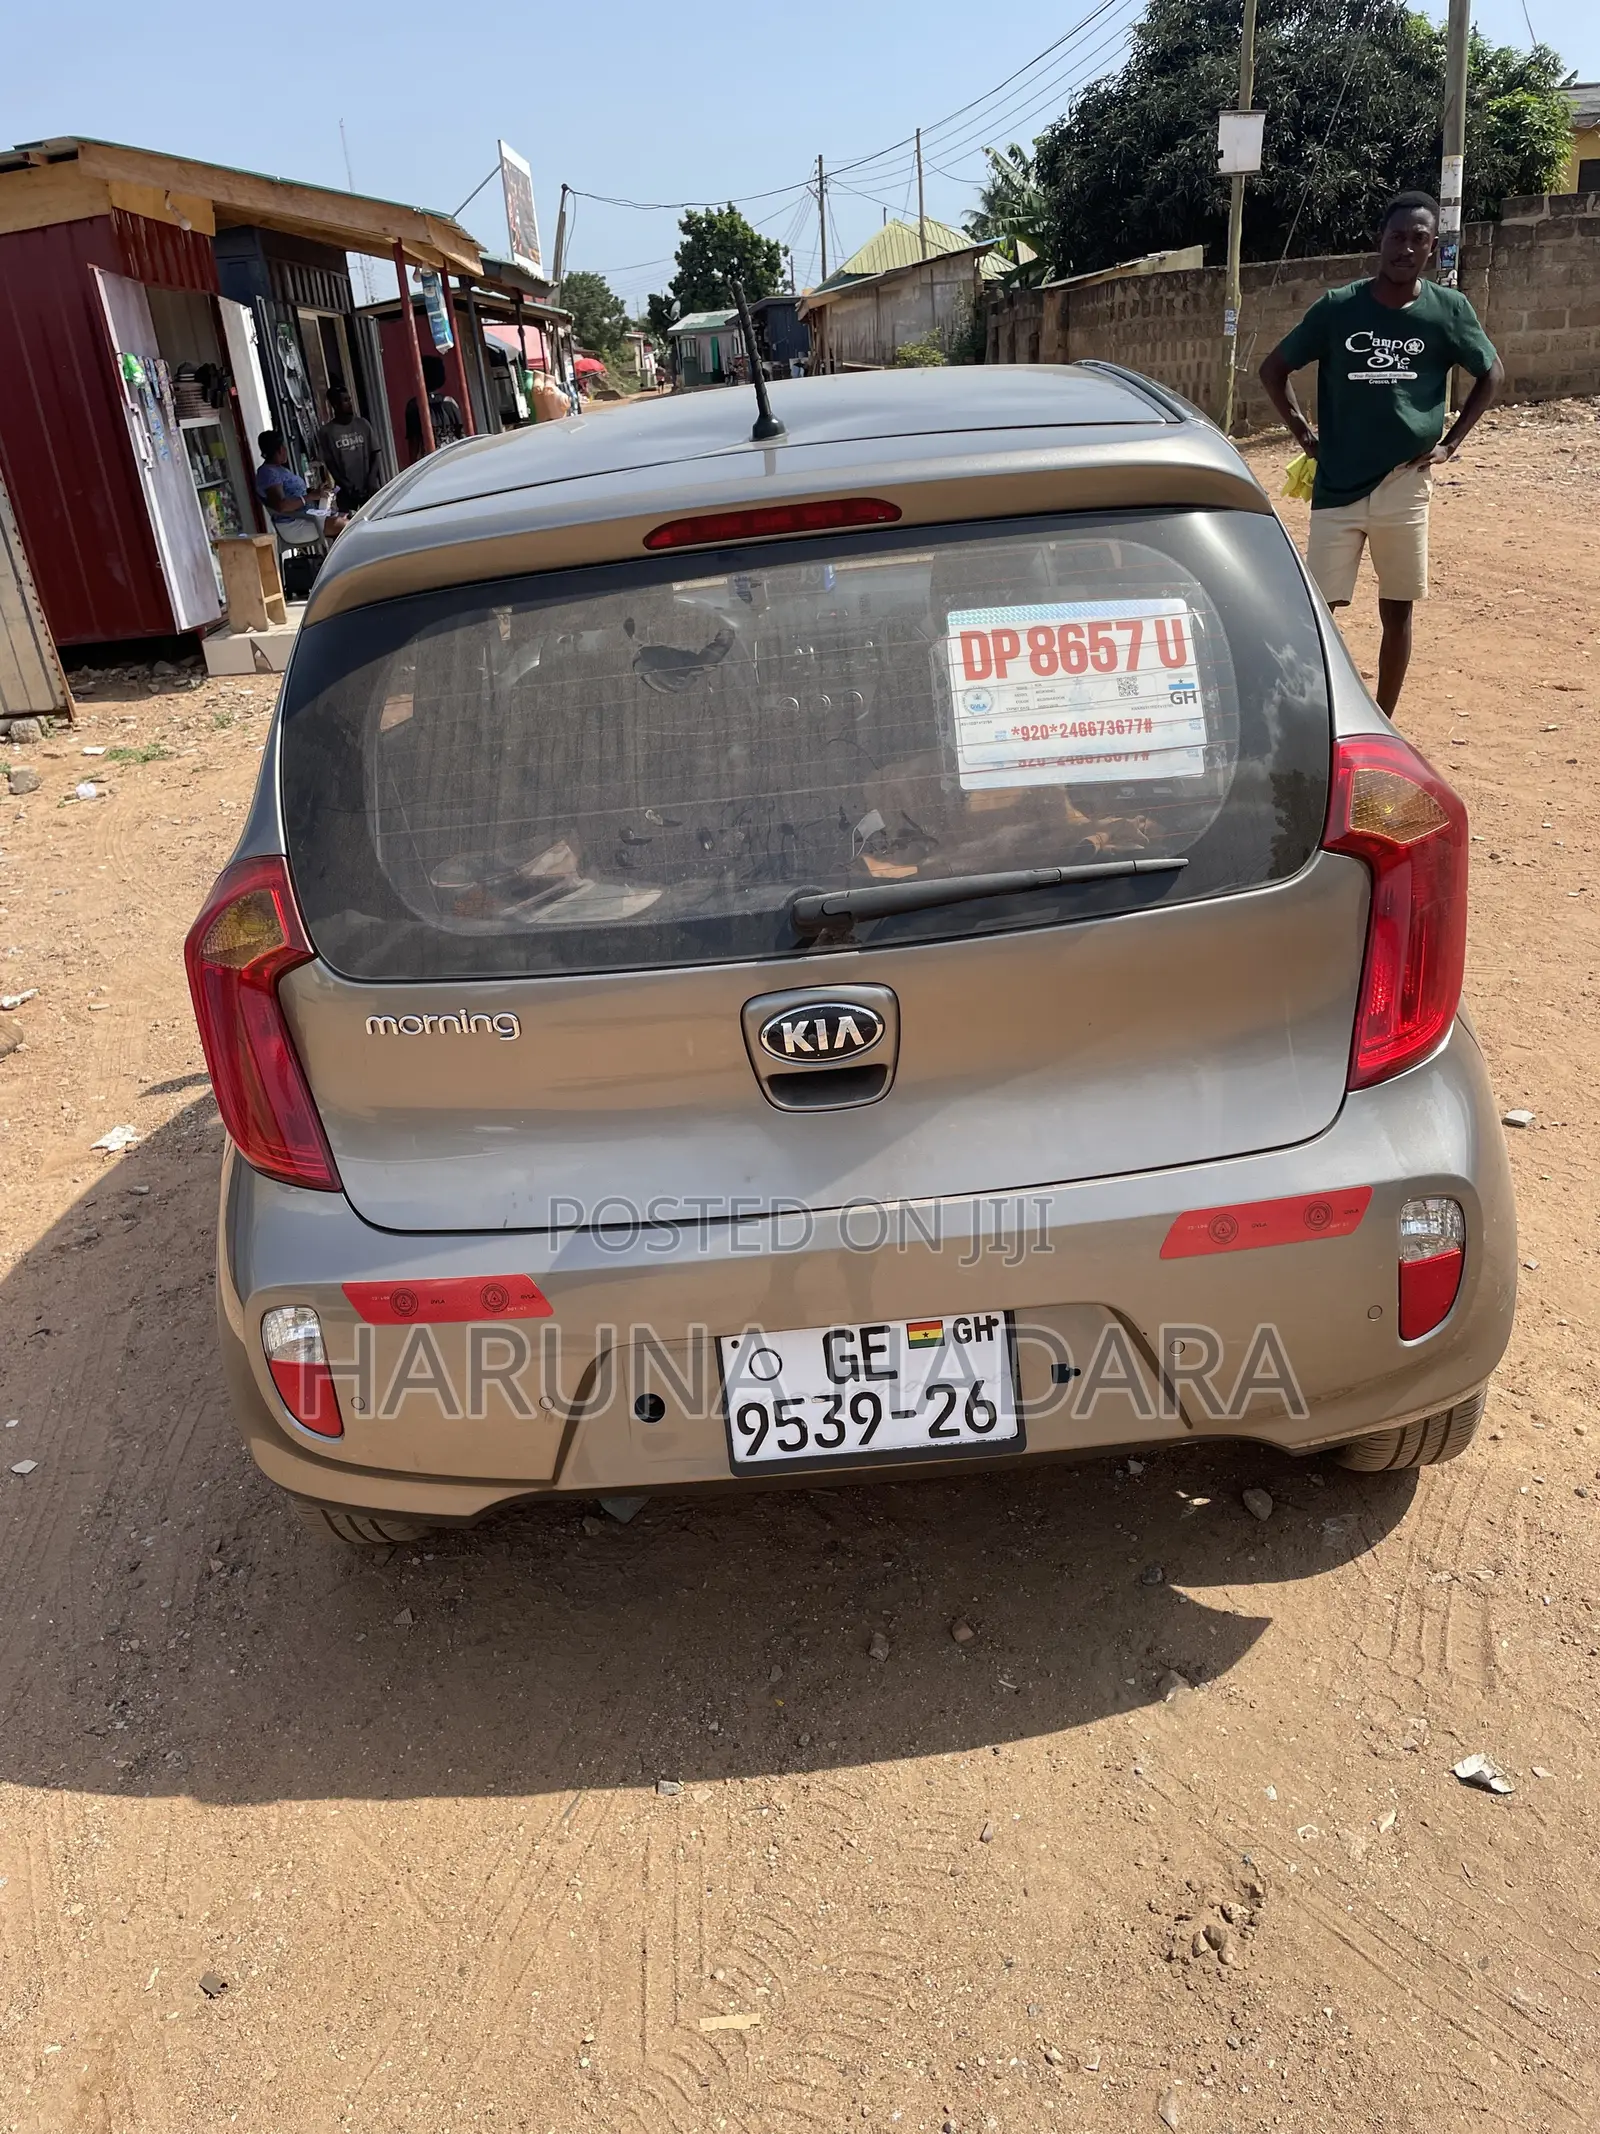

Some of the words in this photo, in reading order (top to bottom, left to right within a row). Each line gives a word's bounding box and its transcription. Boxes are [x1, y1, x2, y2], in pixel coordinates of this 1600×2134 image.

[1345, 331, 1403, 351] Camp
[959, 629, 1021, 681] DP
[1026, 620, 1144, 677] 8657
[1154, 618, 1188, 669] U
[1169, 690, 1198, 705] GH
[365, 1008, 521, 1041] morning
[780, 1015, 866, 1054] KIA
[822, 1325, 898, 1385] GE
[952, 1315, 996, 1344] GH
[736, 1379, 998, 1457] 9539-26
